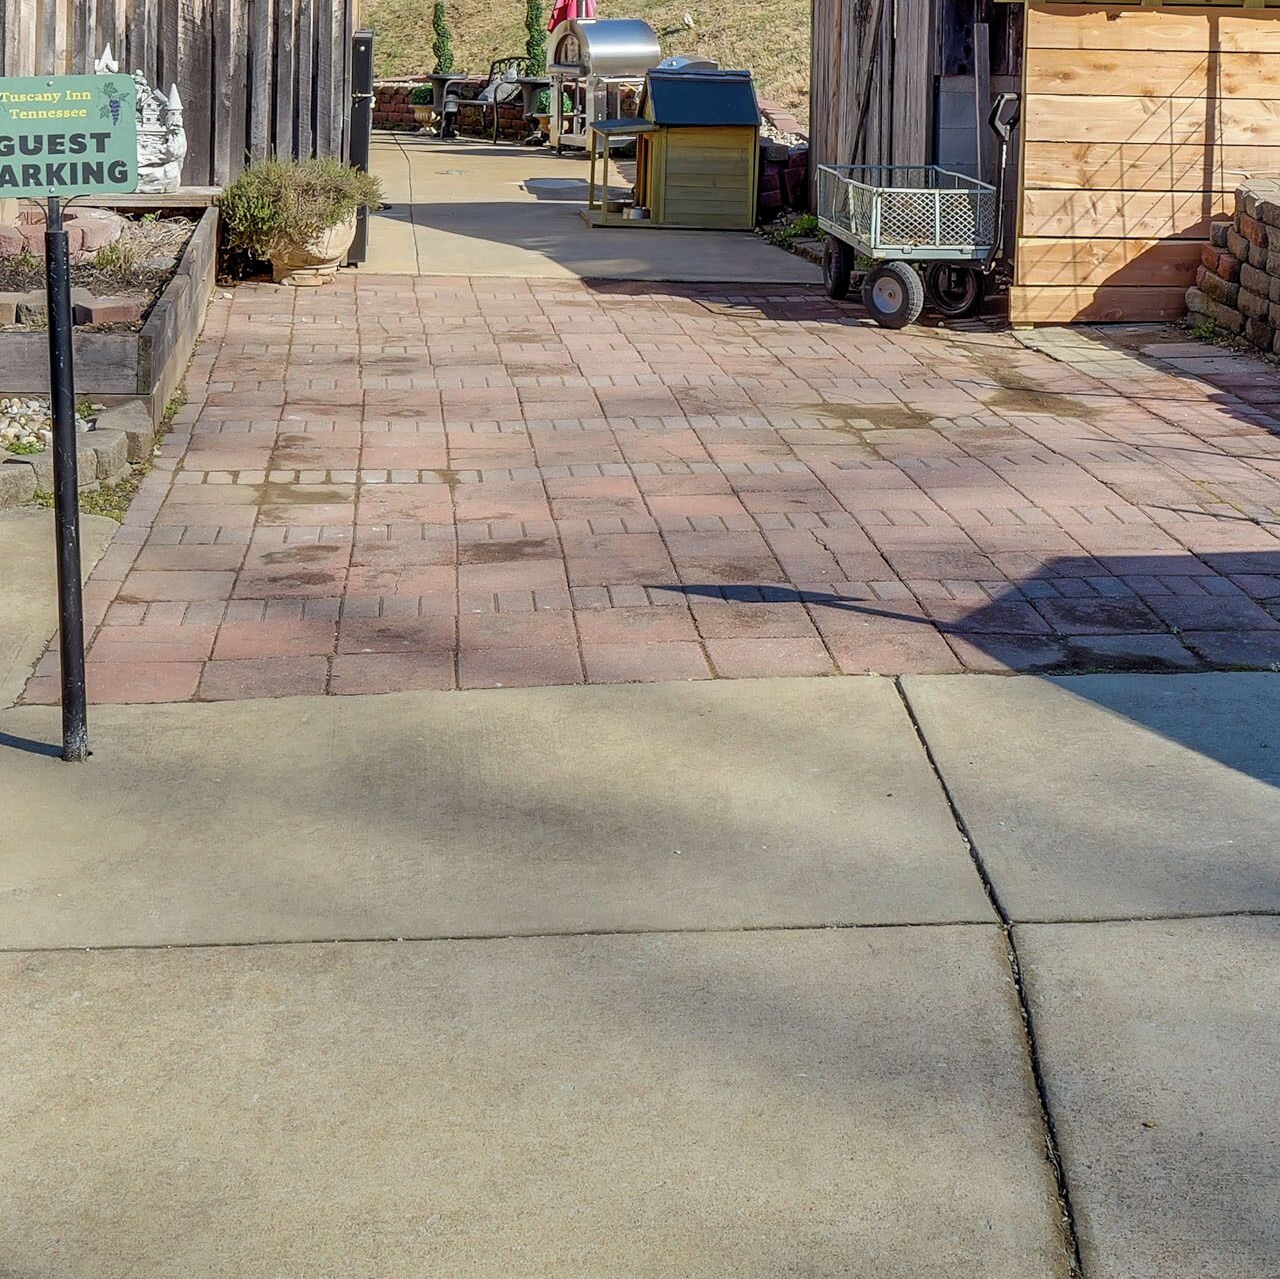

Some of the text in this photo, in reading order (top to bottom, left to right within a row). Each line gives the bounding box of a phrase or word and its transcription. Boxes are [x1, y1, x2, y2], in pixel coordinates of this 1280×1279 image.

[0, 89, 92, 103] Tuscany Inn
[8, 108, 88, 120] Tennessee
